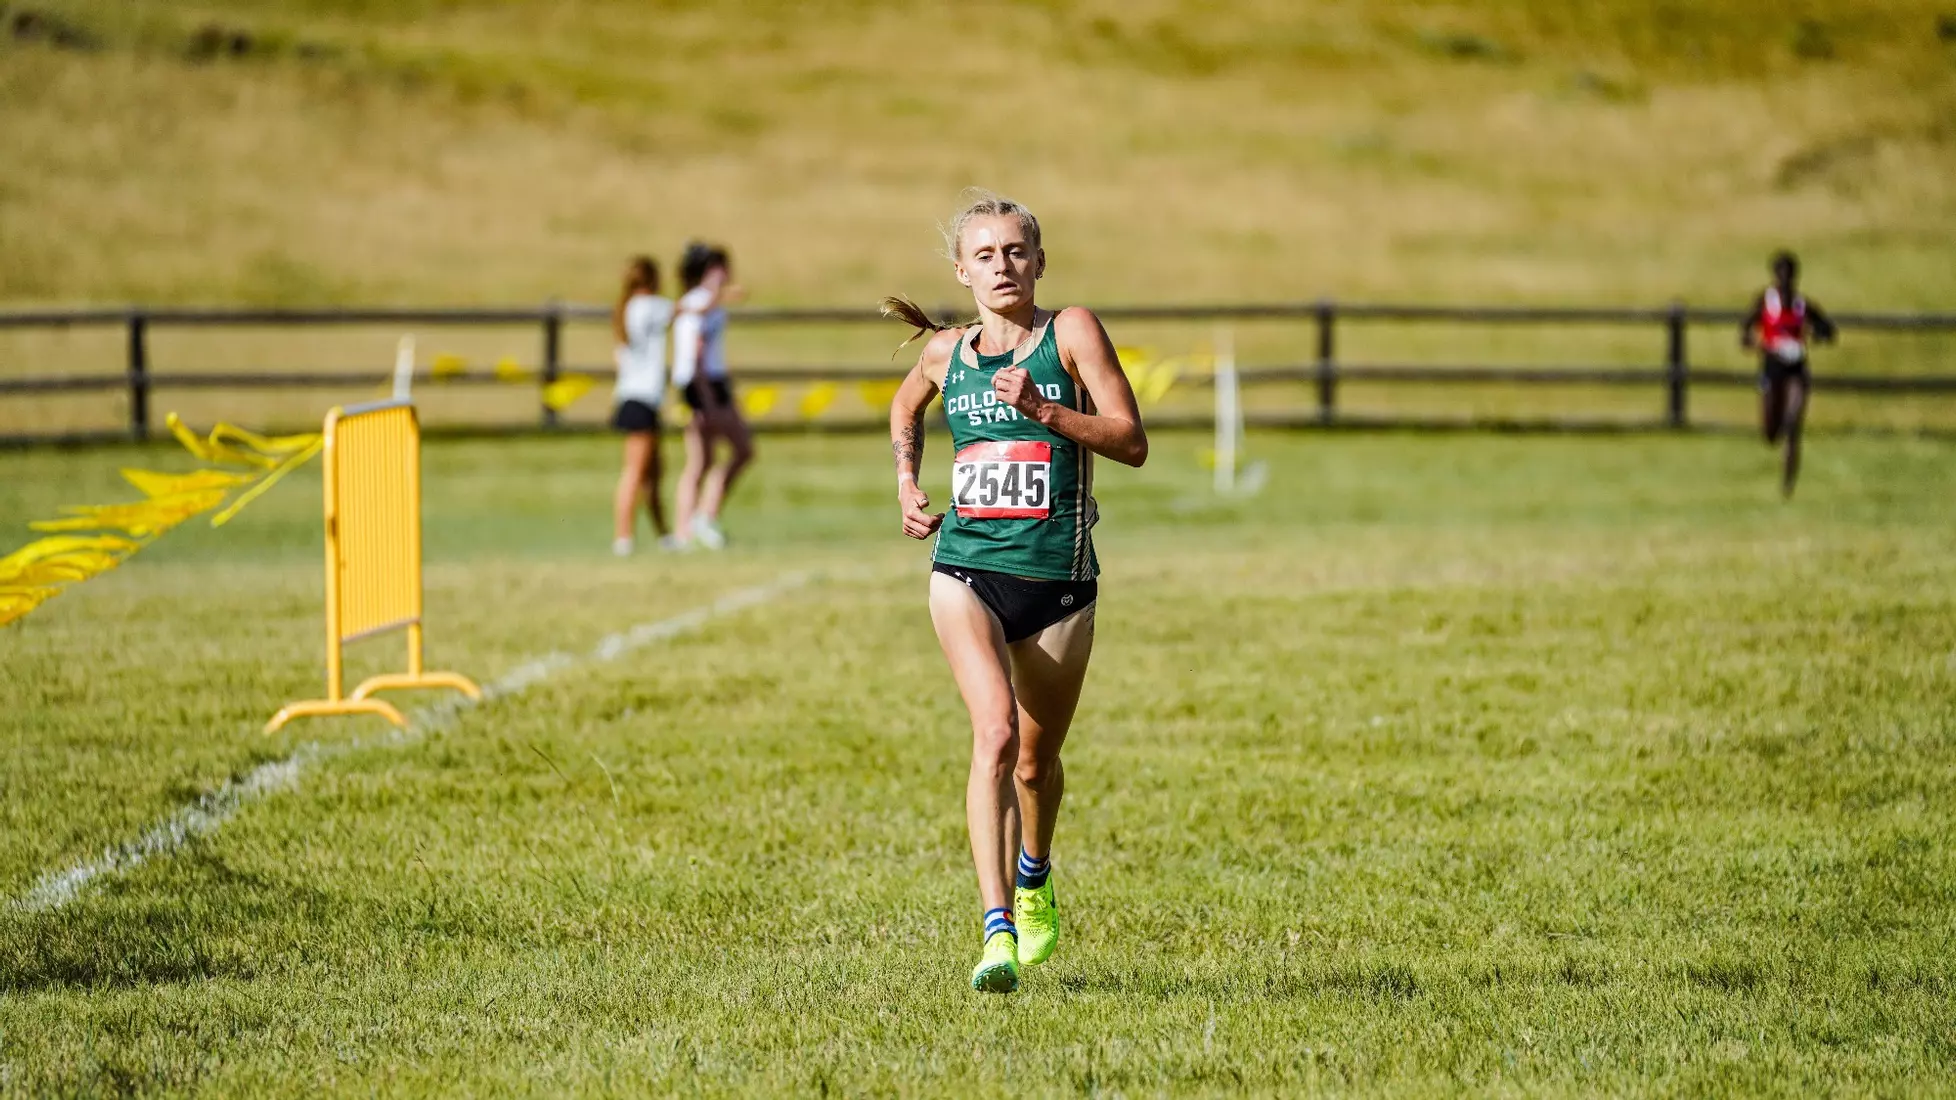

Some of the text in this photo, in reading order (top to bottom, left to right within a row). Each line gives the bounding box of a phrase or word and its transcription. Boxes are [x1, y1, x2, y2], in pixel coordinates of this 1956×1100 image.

[947, 383, 1061, 415] COLOO
[967, 405, 1029, 426] STAT
[958, 463, 1045, 507] 2545
